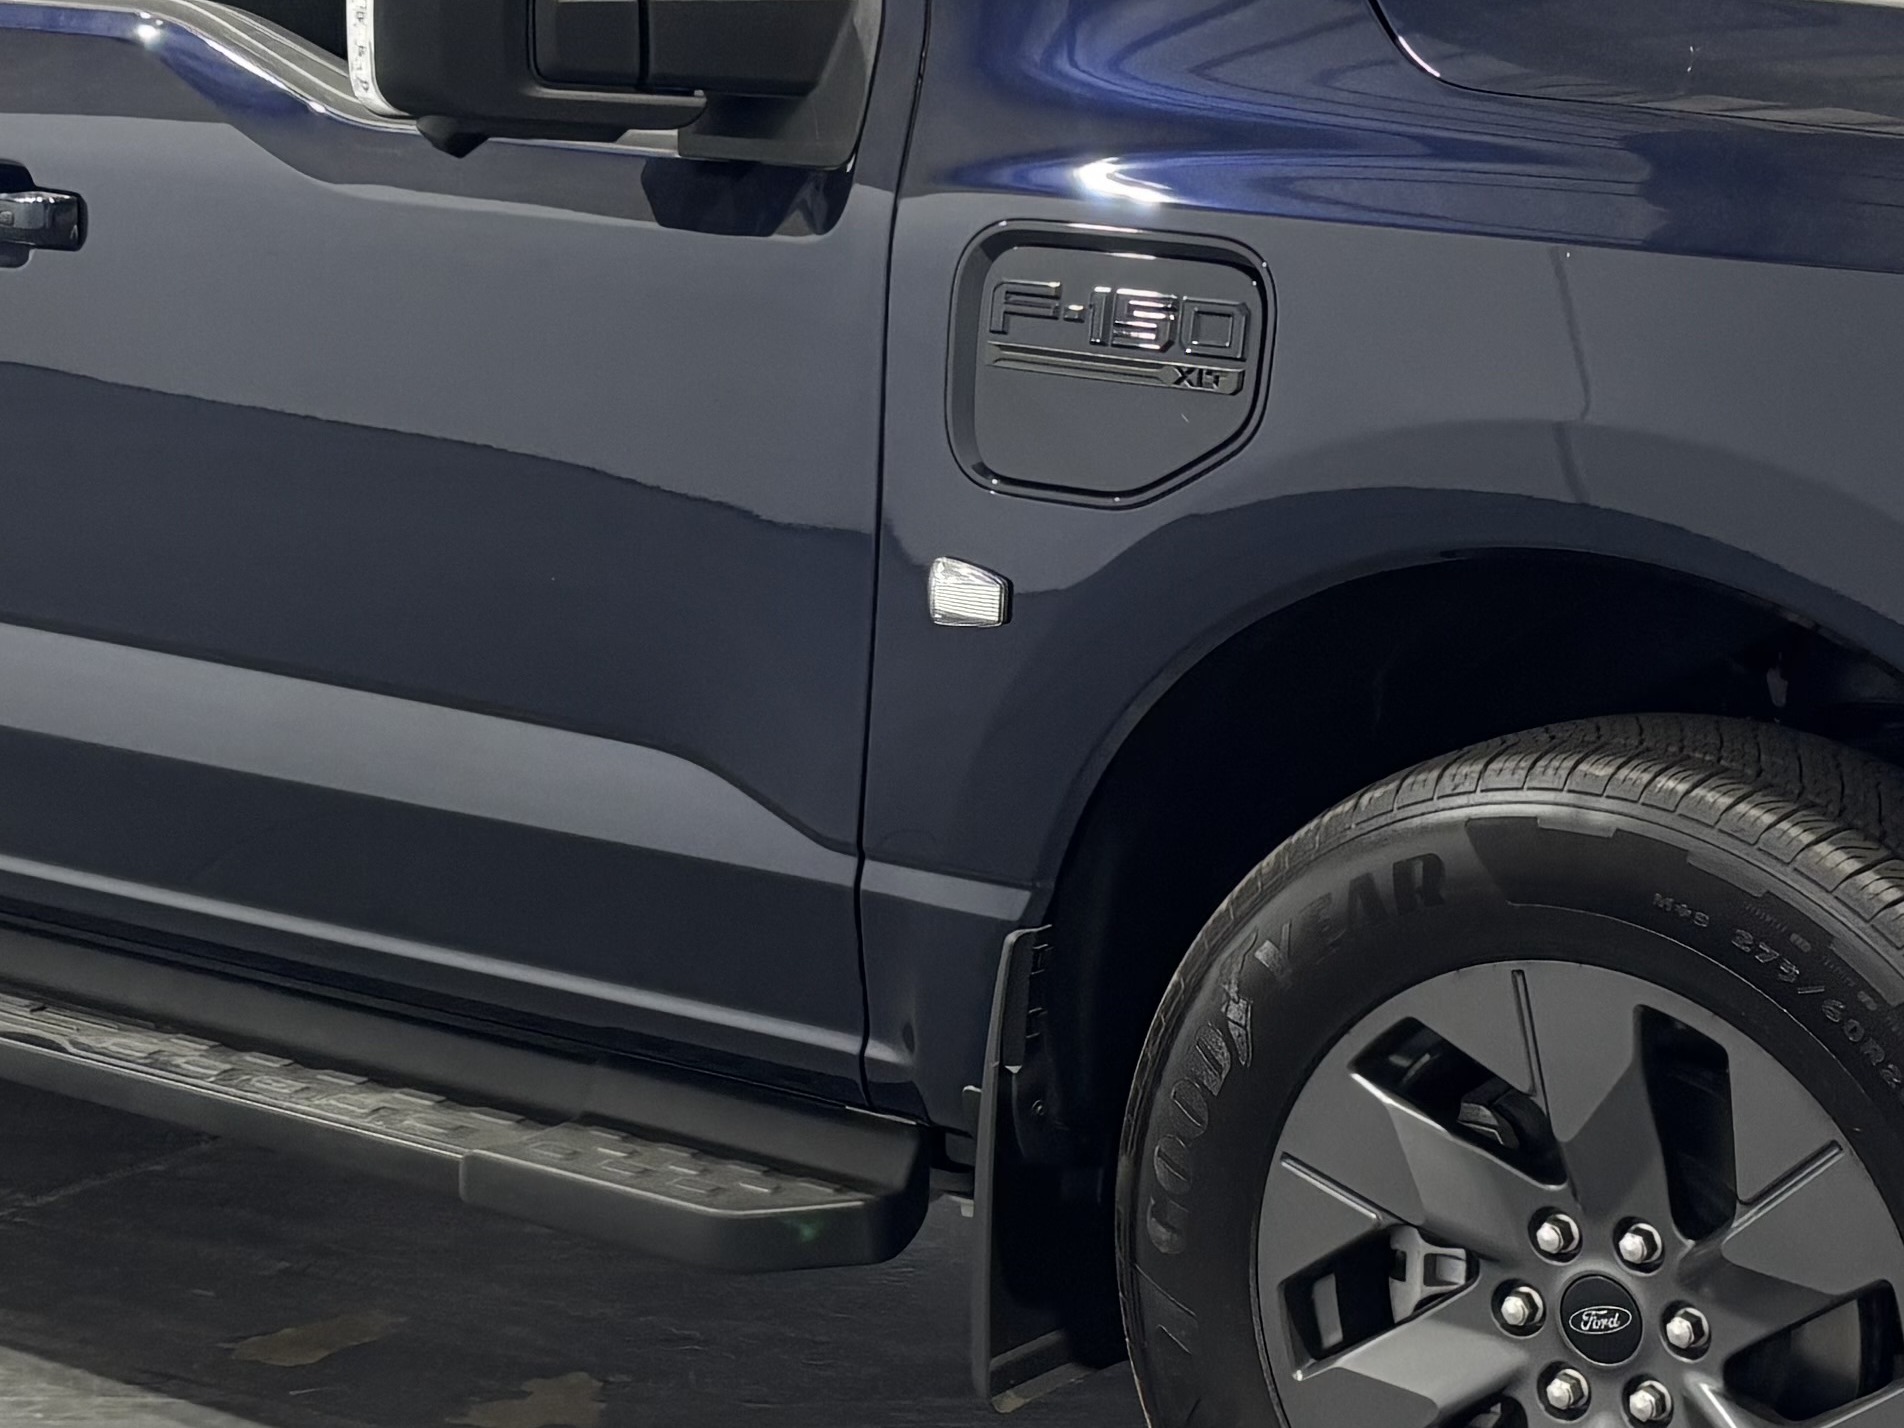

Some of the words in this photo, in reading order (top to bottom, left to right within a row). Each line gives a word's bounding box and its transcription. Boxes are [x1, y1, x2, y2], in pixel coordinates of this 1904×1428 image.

[989, 279, 1250, 361] F-150
[1146, 853, 1446, 1255] GOODYEAR
[1580, 1309, 1621, 1331] Ford
